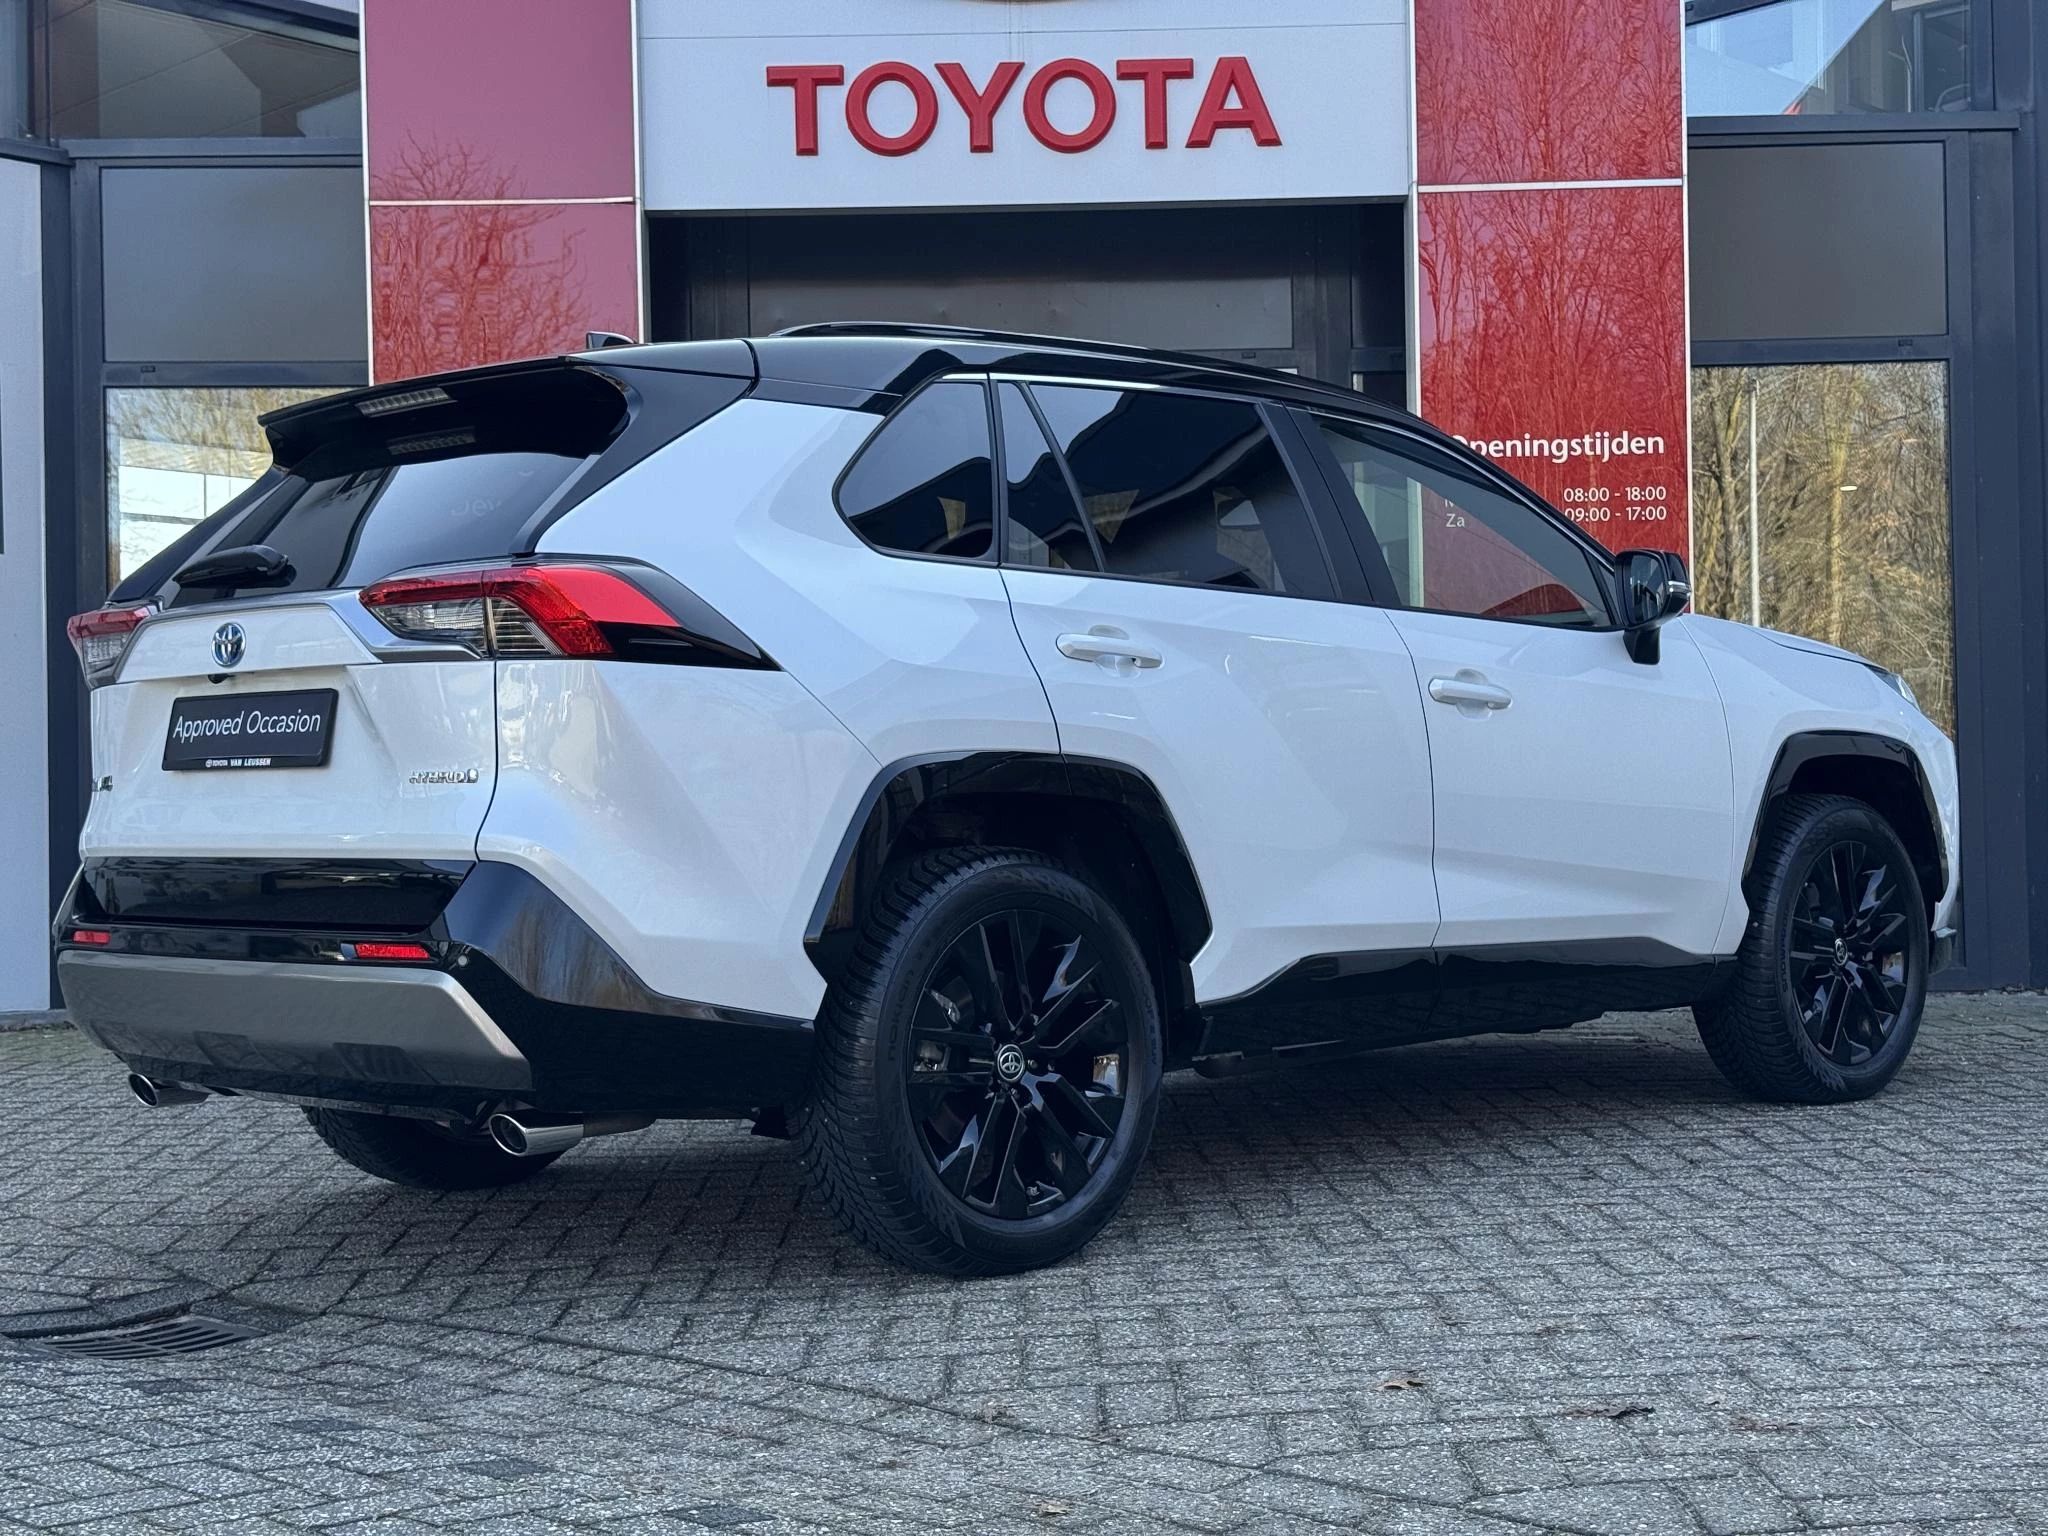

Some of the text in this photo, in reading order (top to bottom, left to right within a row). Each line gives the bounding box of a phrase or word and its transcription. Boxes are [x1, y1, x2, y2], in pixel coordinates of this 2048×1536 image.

[766, 56, 1283, 157] TOYOTA
[1563, 487, 1610, 502] 08:00
[1625, 486, 1667, 501] 18:00
[1446, 513, 1465, 528] Za
[1564, 507, 1611, 522] 09:00
[1626, 506, 1667, 521] 17:00
[173, 708, 321, 744] Approved Occasion
[230, 758, 243, 767] VAN
